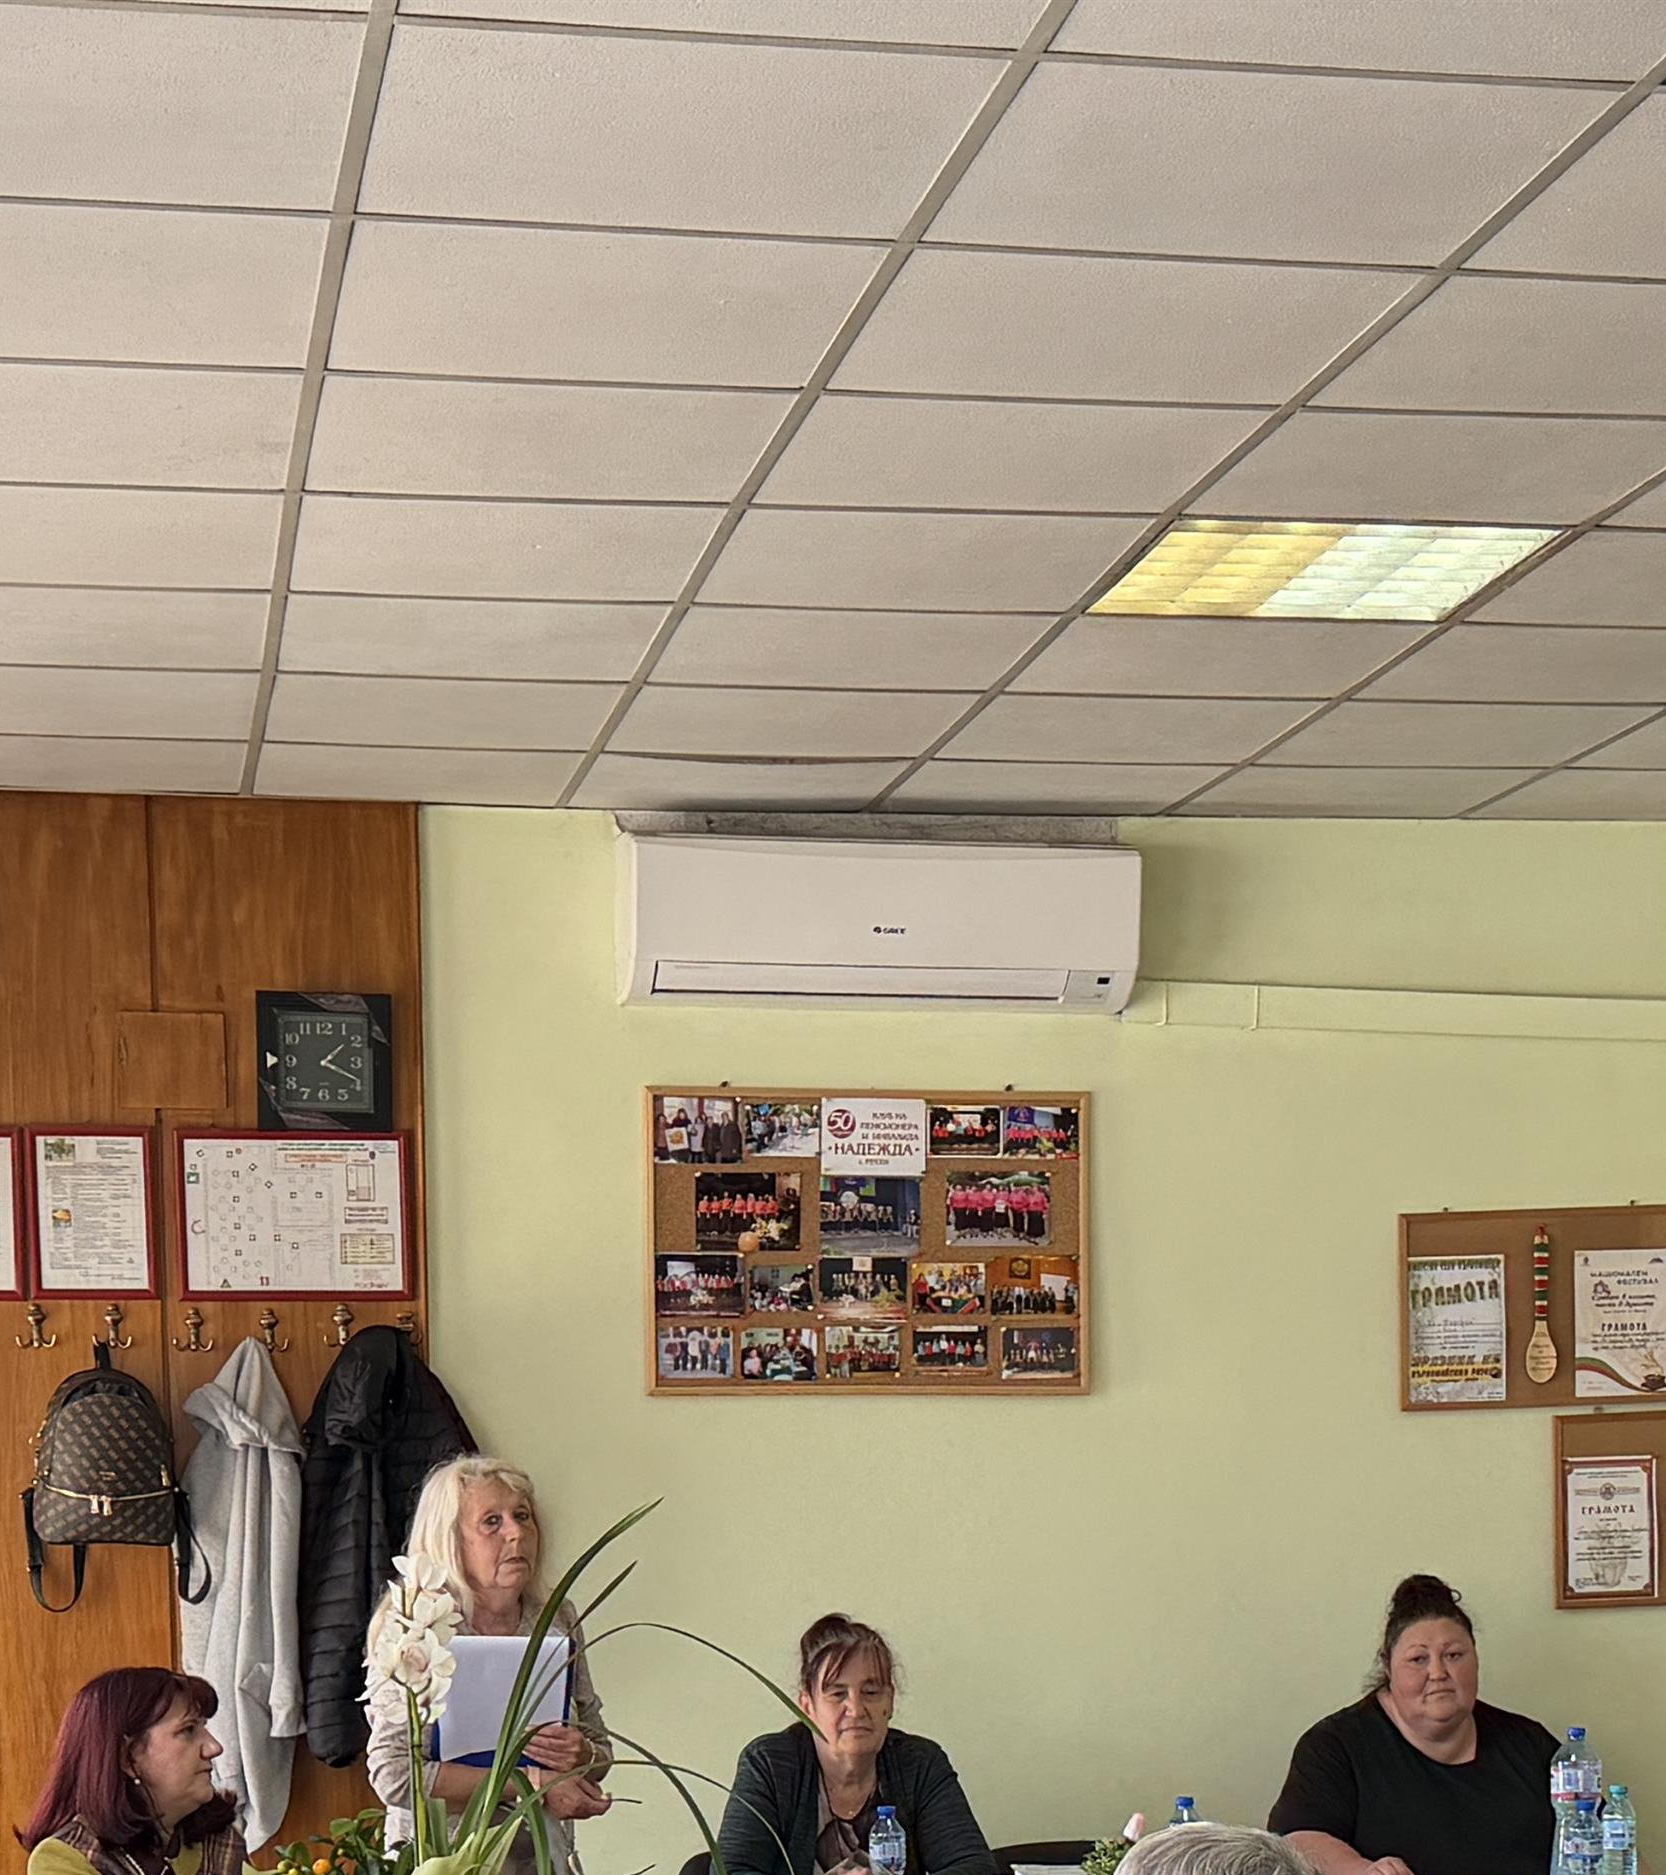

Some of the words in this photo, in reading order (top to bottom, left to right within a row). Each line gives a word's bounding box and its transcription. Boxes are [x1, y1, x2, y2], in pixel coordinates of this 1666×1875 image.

[299, 1022, 311, 1035] 11
[316, 1022, 333, 1035] 12
[341, 1023, 346, 1035] 1
[285, 1033, 300, 1045] 10
[351, 1035, 362, 1047] 2
[285, 1055, 297, 1067] 9
[350, 1057, 362, 1069] 3
[286, 1076, 297, 1090] 8
[299, 1088, 311, 1100] 7
[318, 1088, 330, 1101] 6
[337, 1089, 348, 1100] 5
[827, 1112, 853, 1130] 50
[834, 1142, 913, 1156] НАДЕЖДА
[1410, 1278, 1500, 1310] ГРАМОТА
[1601, 1322, 1647, 1332] ГРАМОТА
[1581, 1504, 1636, 1517] ГРАМОТА
